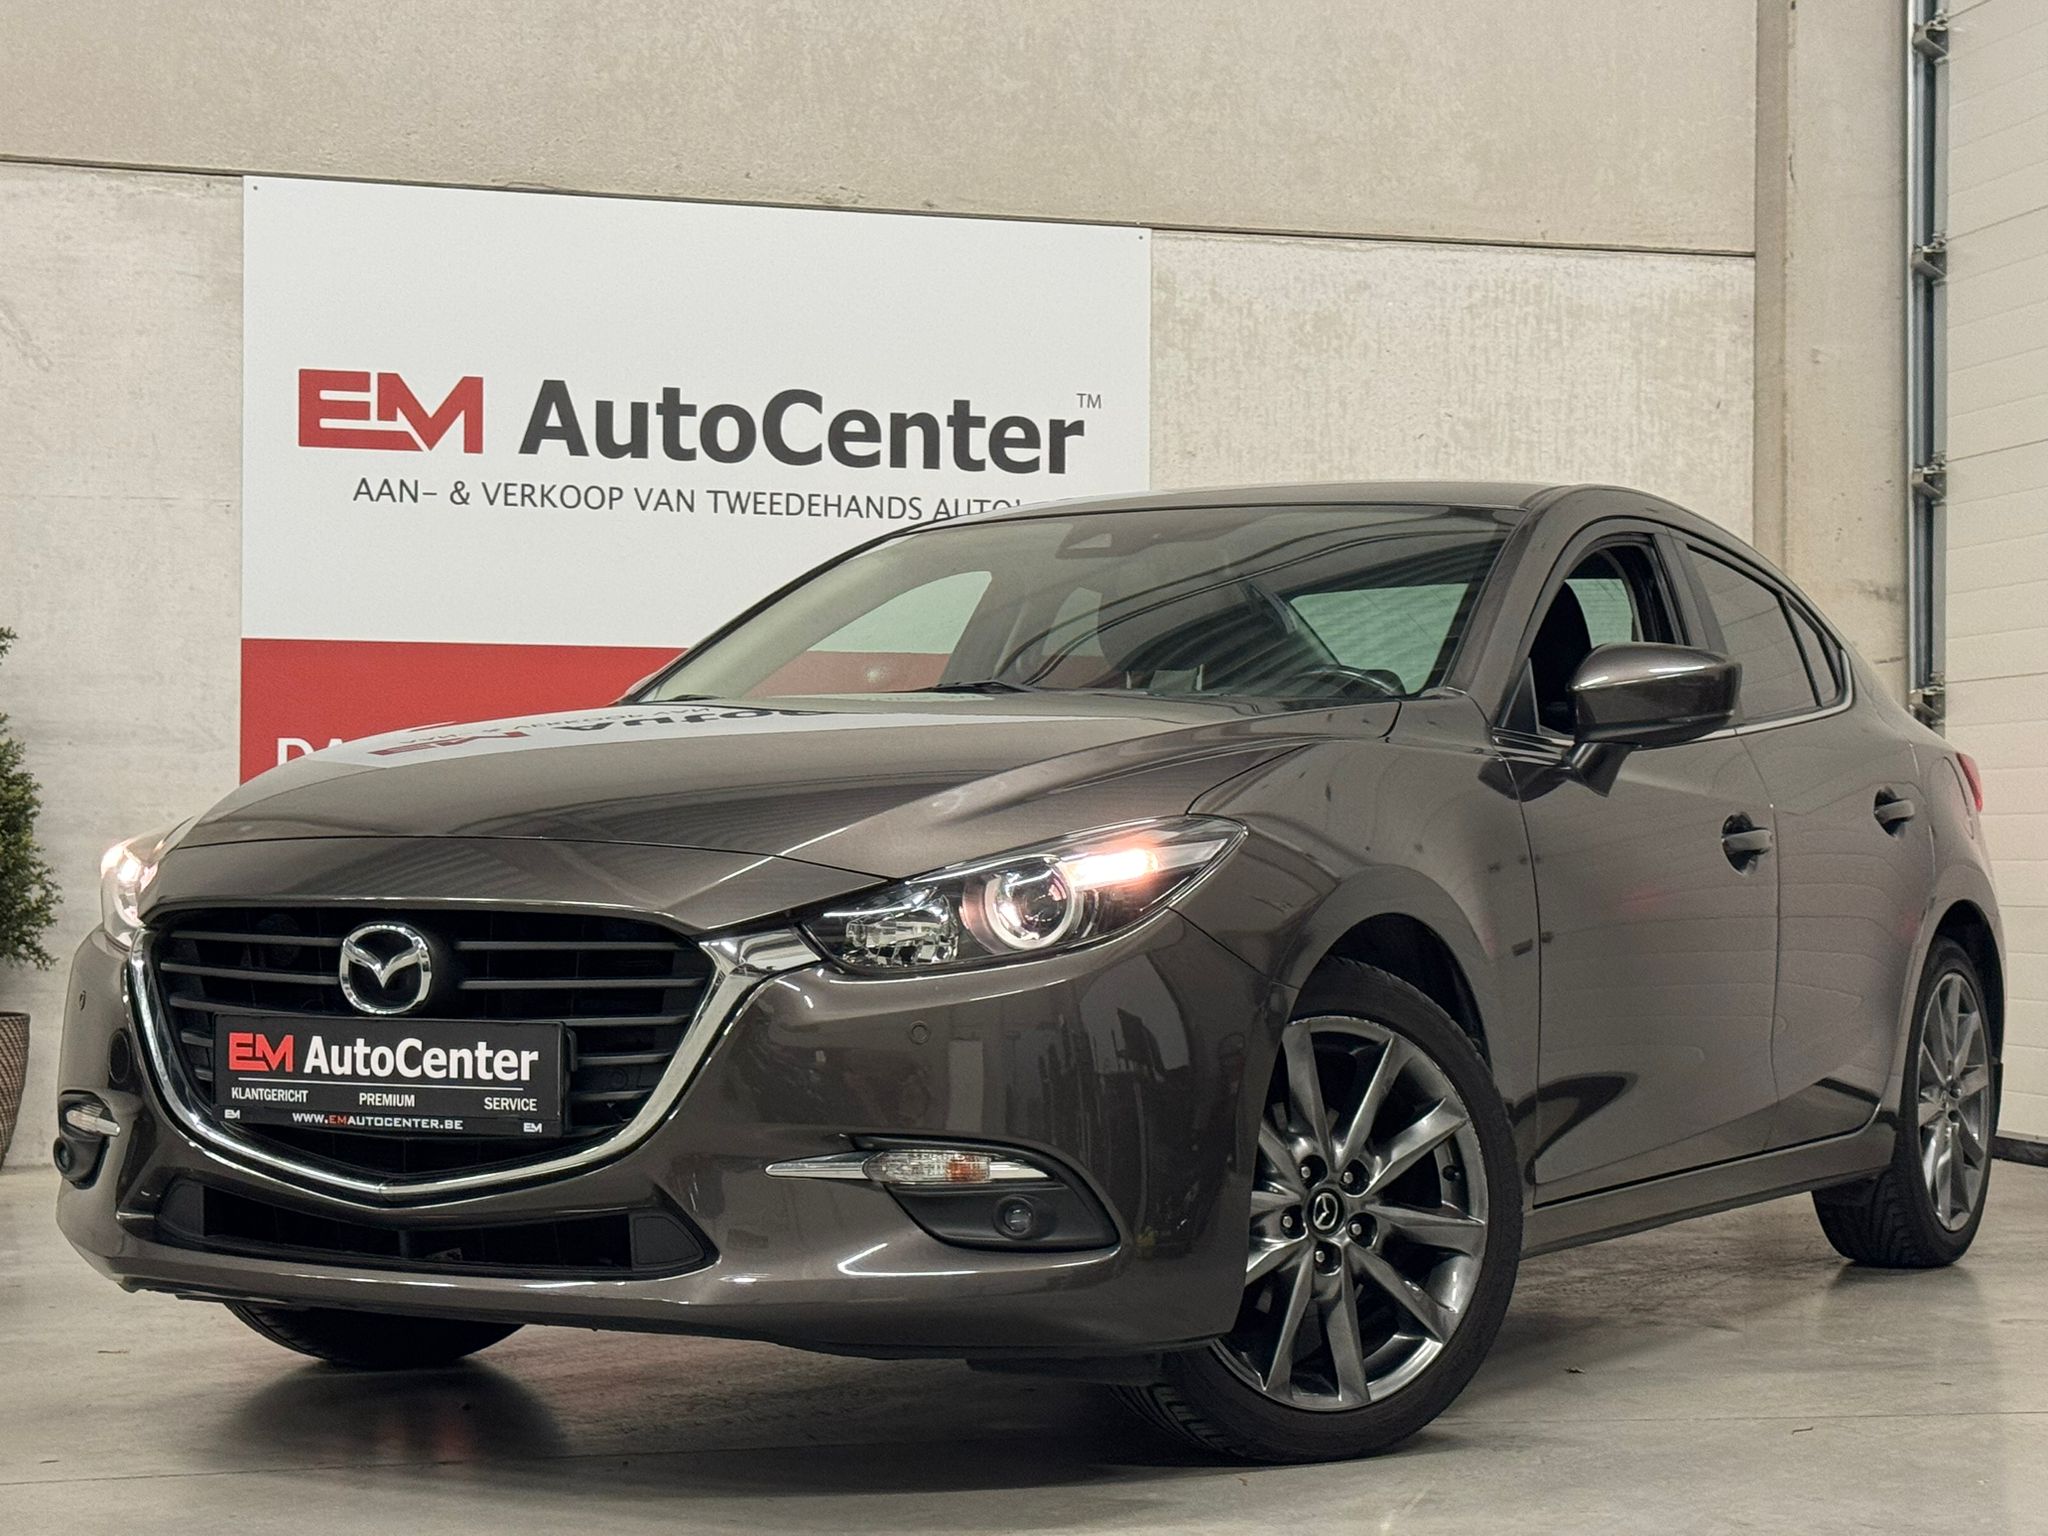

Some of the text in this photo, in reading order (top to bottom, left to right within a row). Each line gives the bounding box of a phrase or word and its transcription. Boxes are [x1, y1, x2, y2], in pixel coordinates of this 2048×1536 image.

[299, 369, 484, 454] EM
[519, 379, 1085, 474] AutoCenter
[353, 477, 437, 503] AAN-
[449, 480, 470, 505] &
[482, 482, 623, 510] VERKOOP
[633, 487, 695, 513] VAN
[706, 490, 922, 520] TWEEDEHANDS
[229, 1031, 539, 1081] EM AutoCenter
[231, 1086, 538, 1112] KLANTGERICHT PREMIUM SERVICE
[224, 1109, 240, 1120] EM
[292, 1112, 463, 1130] WWW.EMAUTOCENTER.BE
[523, 1122, 543, 1133] EM
